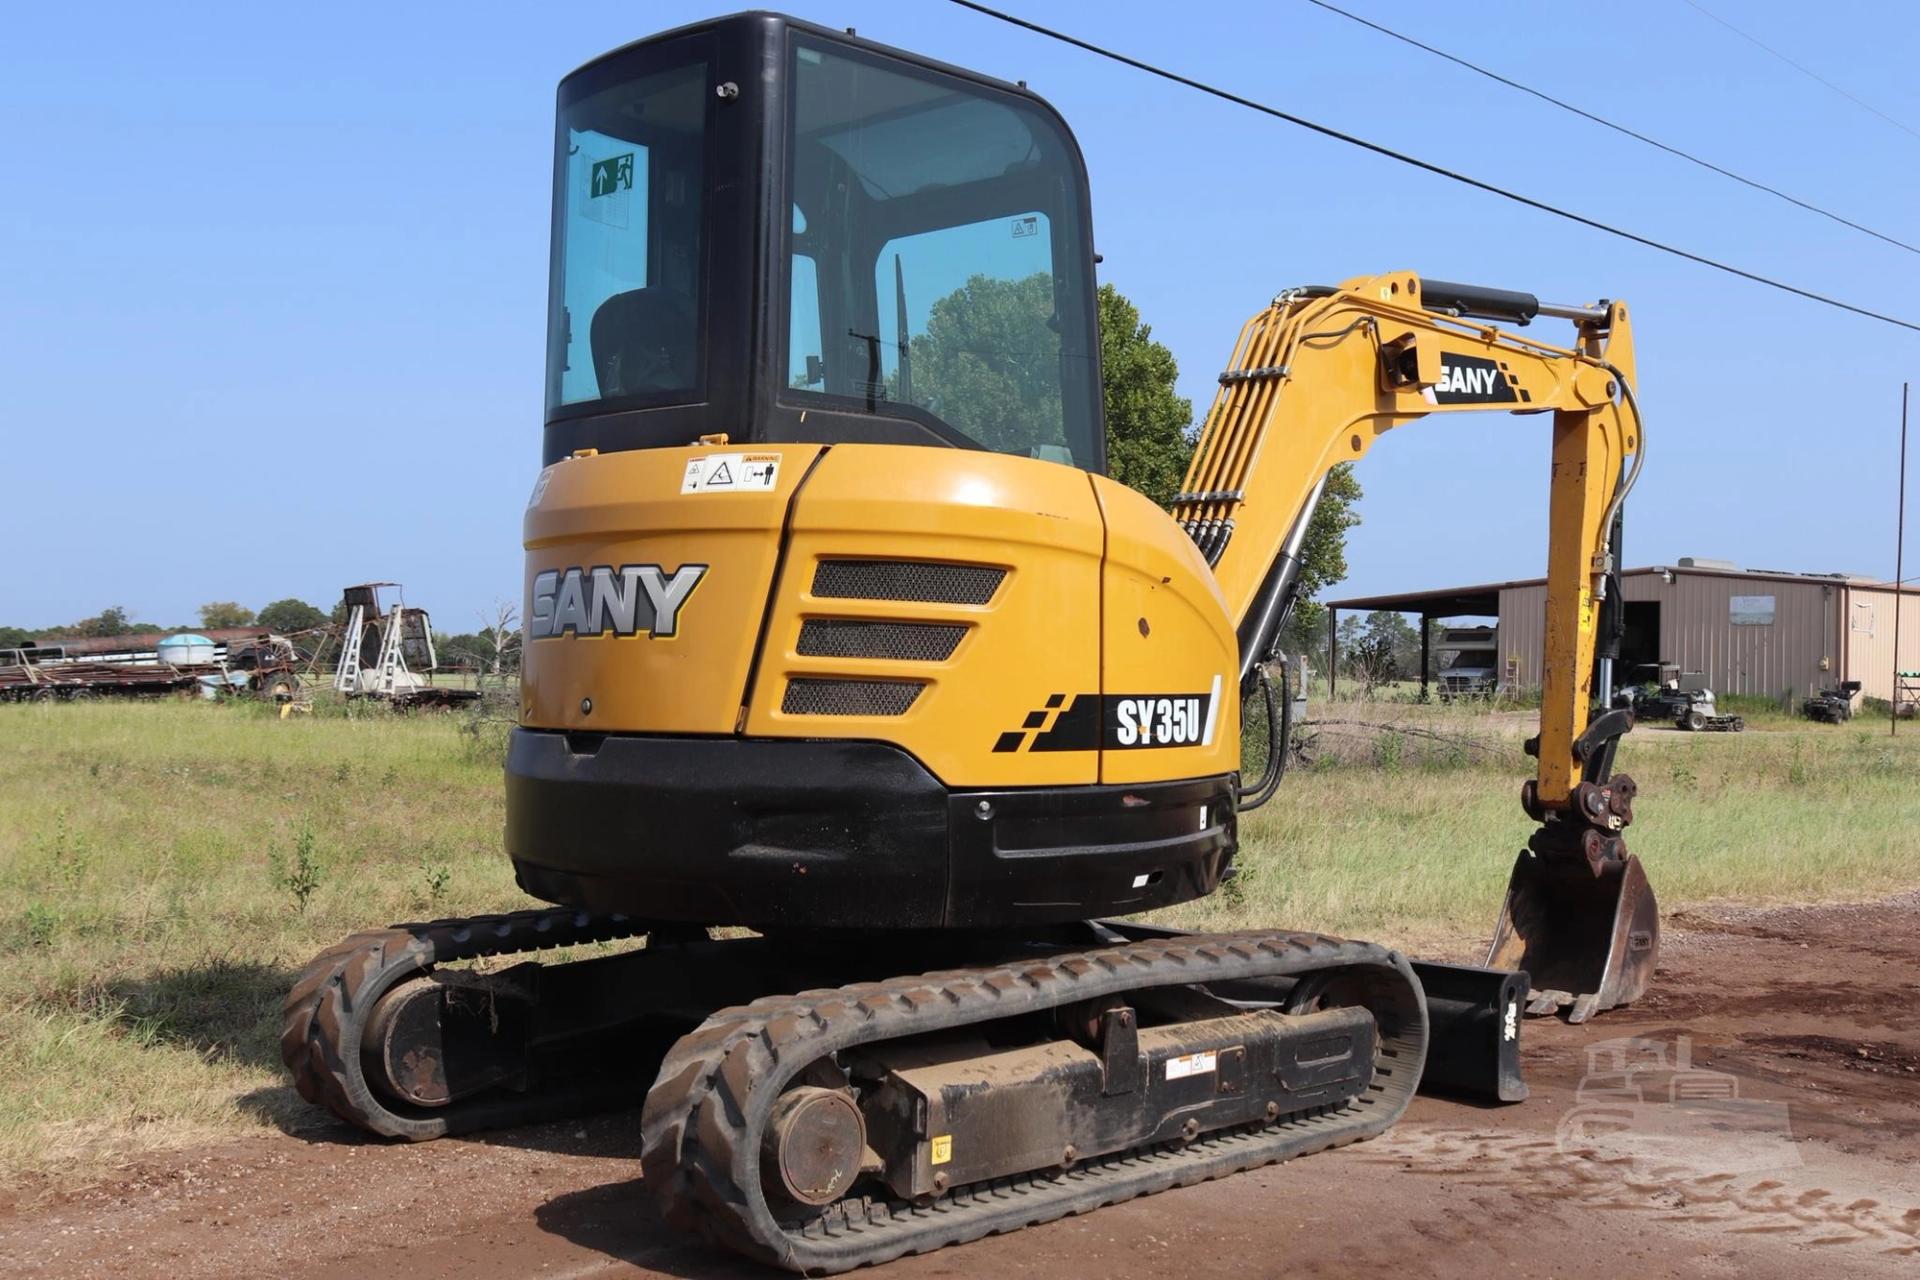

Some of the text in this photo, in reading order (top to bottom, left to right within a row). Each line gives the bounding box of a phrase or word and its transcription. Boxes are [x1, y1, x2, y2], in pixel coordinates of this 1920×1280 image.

[1435, 365, 1497, 395] SANY
[531, 565, 708, 638] SANY
[1117, 698, 1200, 746] SY35U
